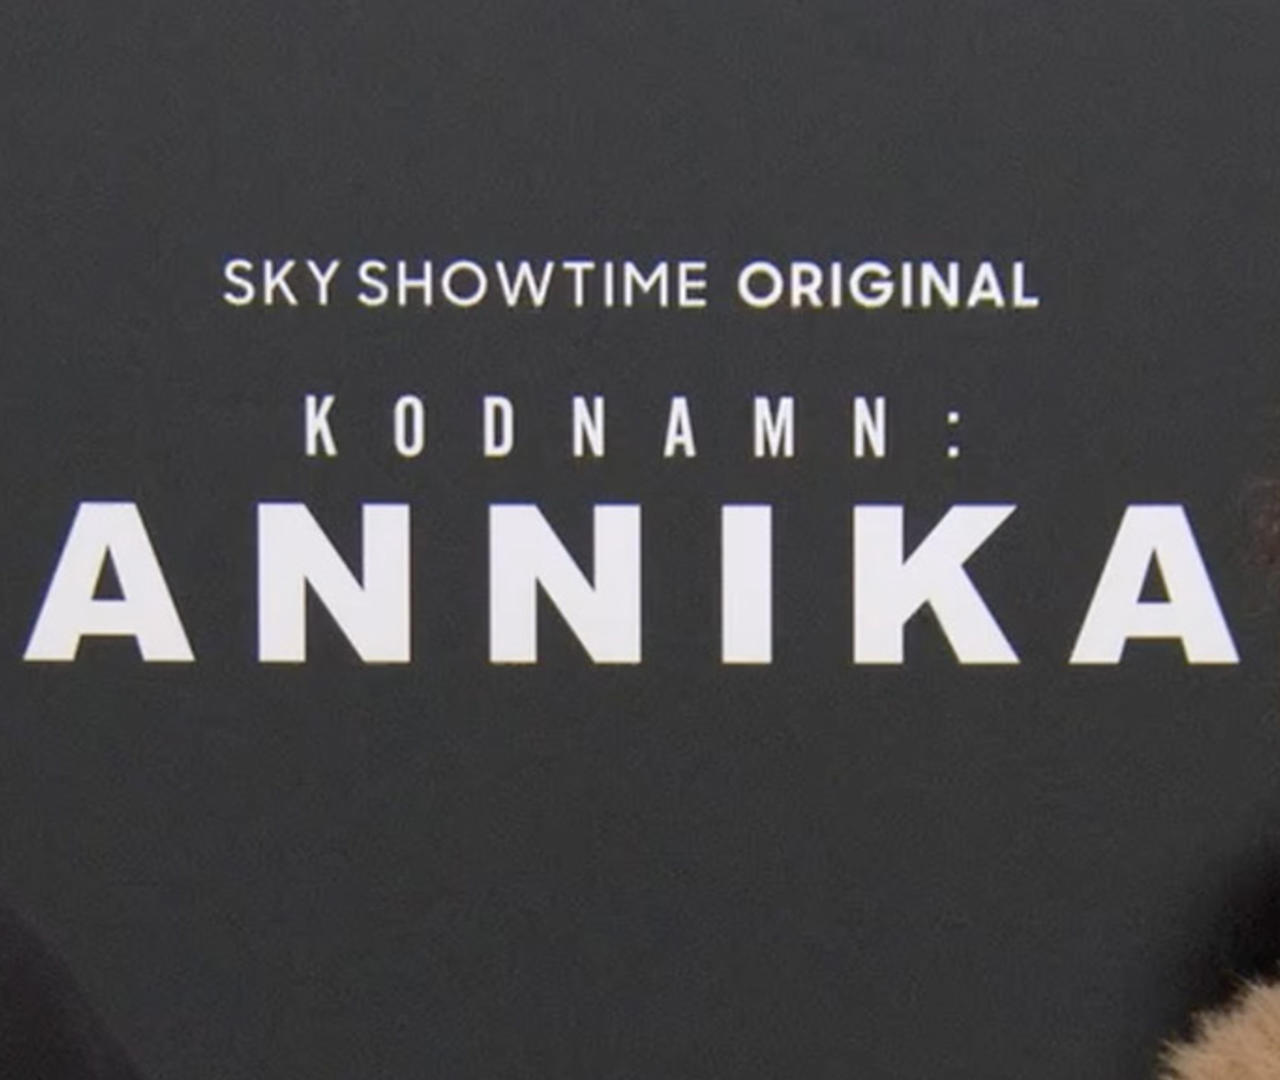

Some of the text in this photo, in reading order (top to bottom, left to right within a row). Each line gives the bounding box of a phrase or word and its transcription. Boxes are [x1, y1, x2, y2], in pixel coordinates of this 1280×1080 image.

[737, 260, 1039, 309] ORIGINAL
[304, 394, 960, 459] KODNAMN:
[22, 501, 1240, 665] ANNIKA
